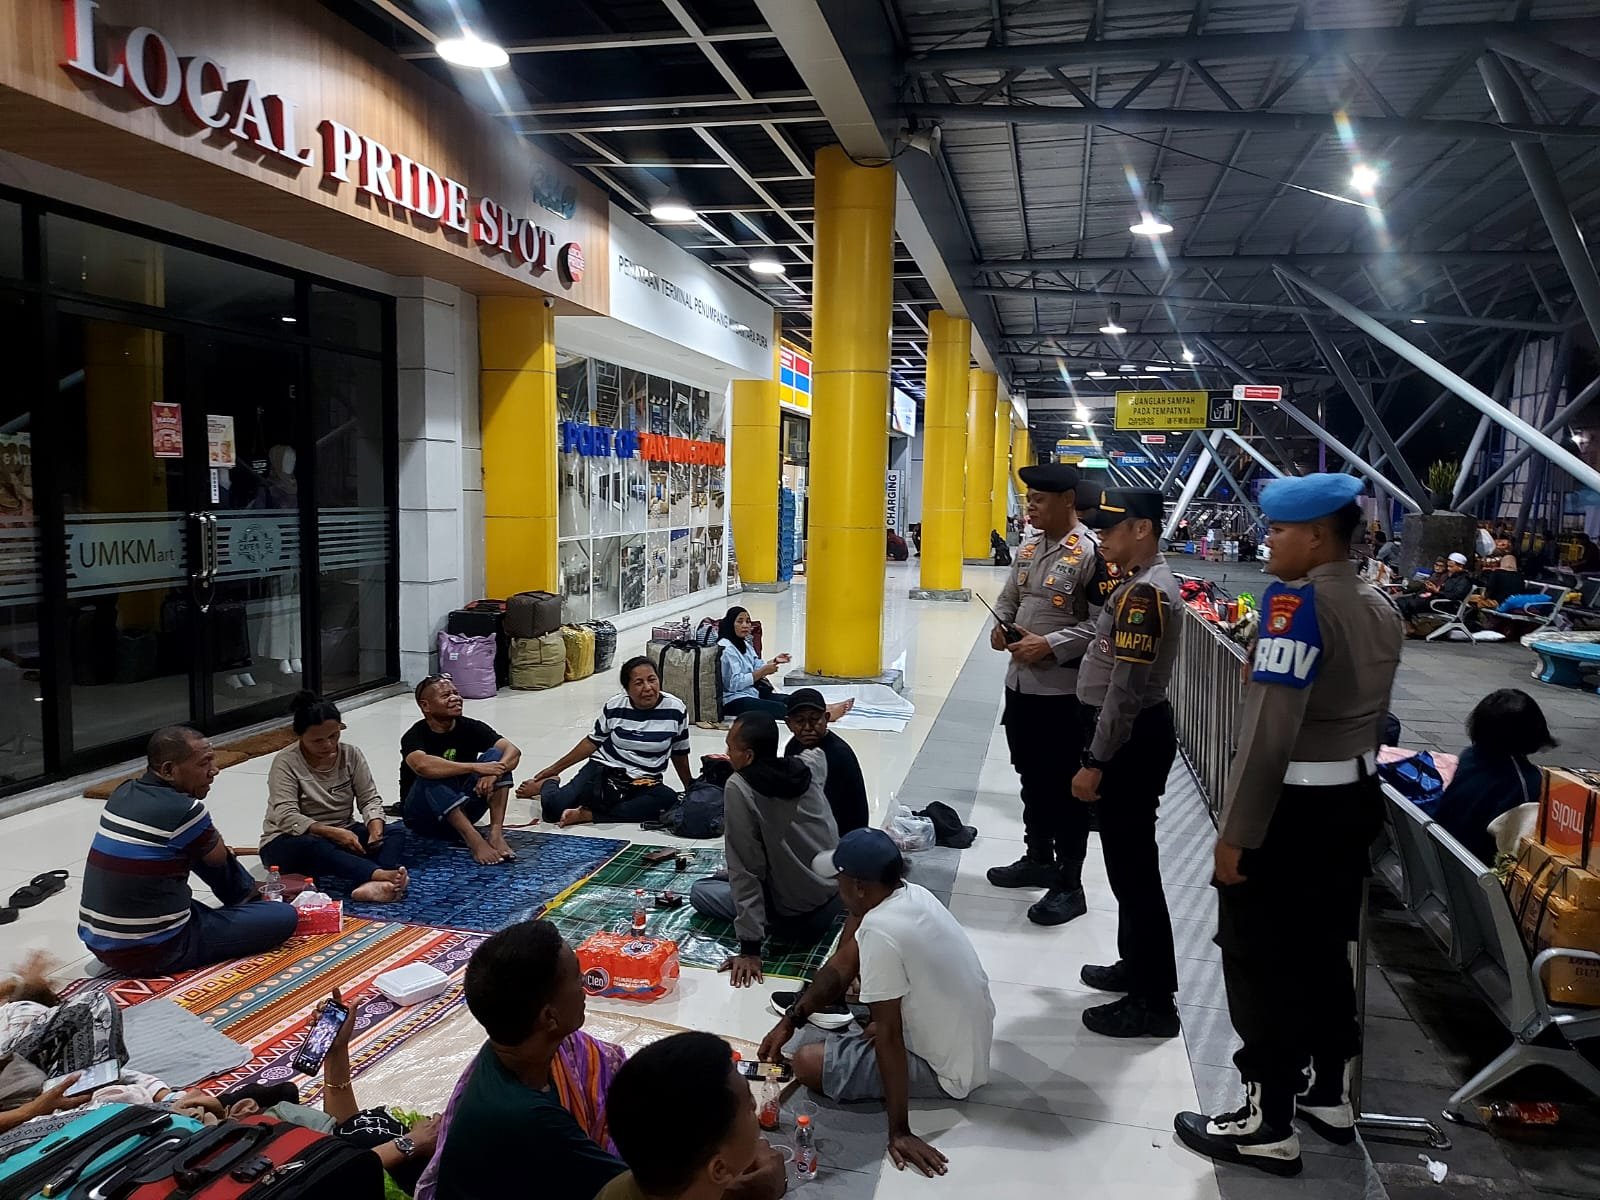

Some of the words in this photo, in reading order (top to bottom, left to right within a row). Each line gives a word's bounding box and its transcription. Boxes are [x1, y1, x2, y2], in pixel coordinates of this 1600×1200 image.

[64, 0, 315, 167] LOCAL
[322, 119, 470, 234] PRIDE
[474, 196, 557, 272] SPOT
[661, 278, 693, 310] TERMINAL
[694, 297, 729, 329] PENUMPANG
[1133, 407, 1151, 415] PADA
[1152, 406, 1191, 415] TEMPATNYA
[1167, 396, 1195, 405] SAMPAH
[563, 421, 613, 457] PORT
[615, 429, 639, 458] OF
[886, 474, 897, 526] CHARGING
[587, 975, 604, 987] Cleo
